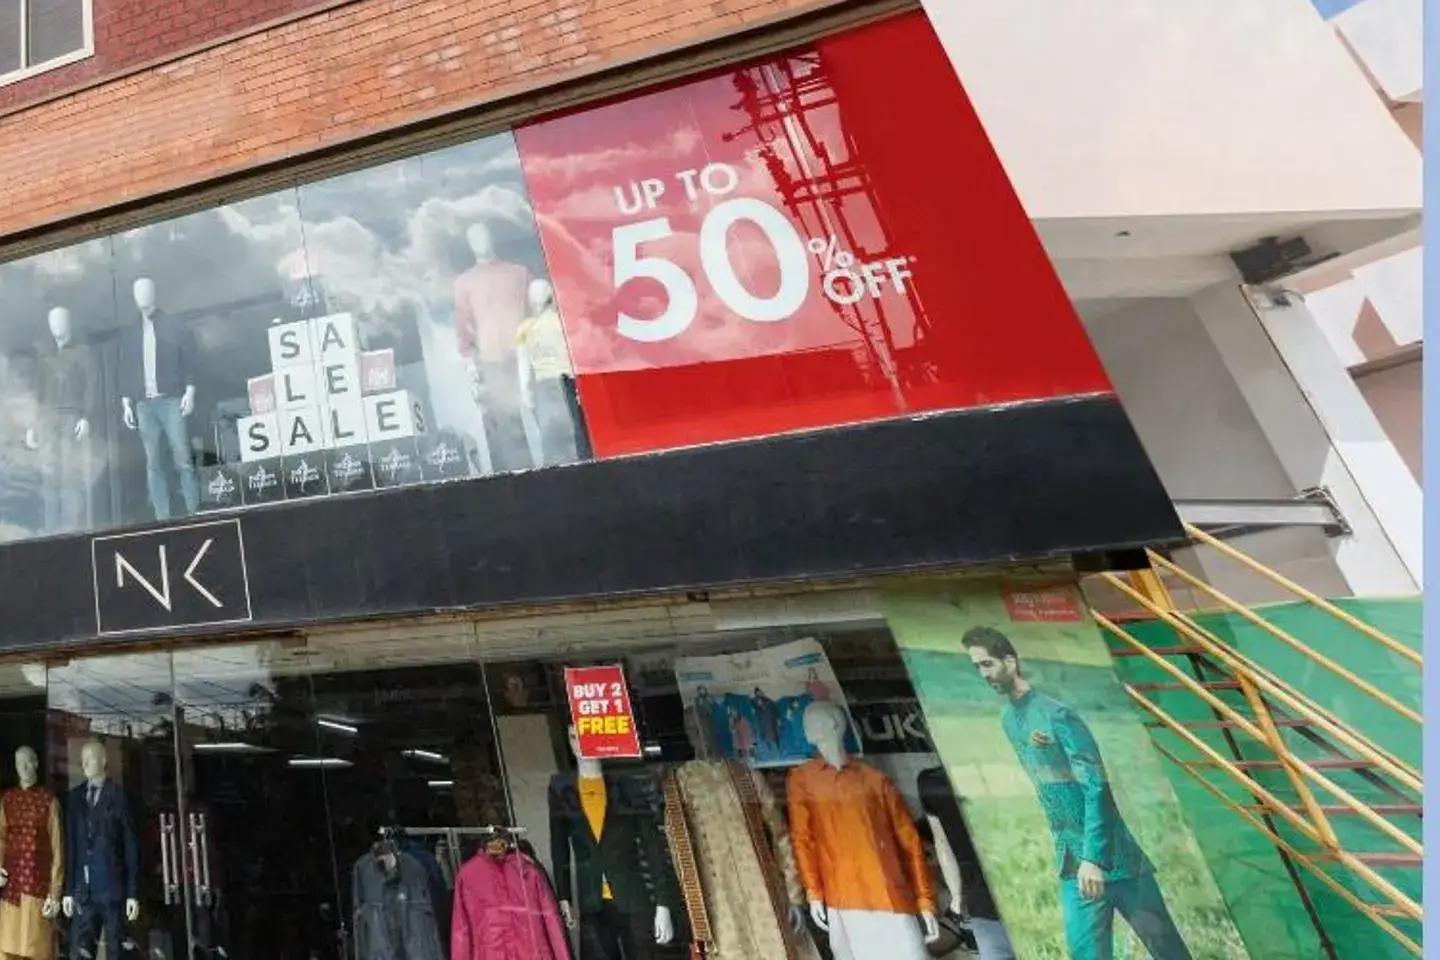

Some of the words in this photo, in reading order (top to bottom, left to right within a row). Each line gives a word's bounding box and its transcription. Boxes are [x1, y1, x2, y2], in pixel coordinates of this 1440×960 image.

[613, 178, 665, 215] UP
[675, 162, 738, 203] TO
[572, 682, 607, 698] BUY
[610, 682, 623, 698] 2
[578, 699, 609, 715] GET
[613, 698, 624, 713] 1
[577, 715, 631, 736] FREE
